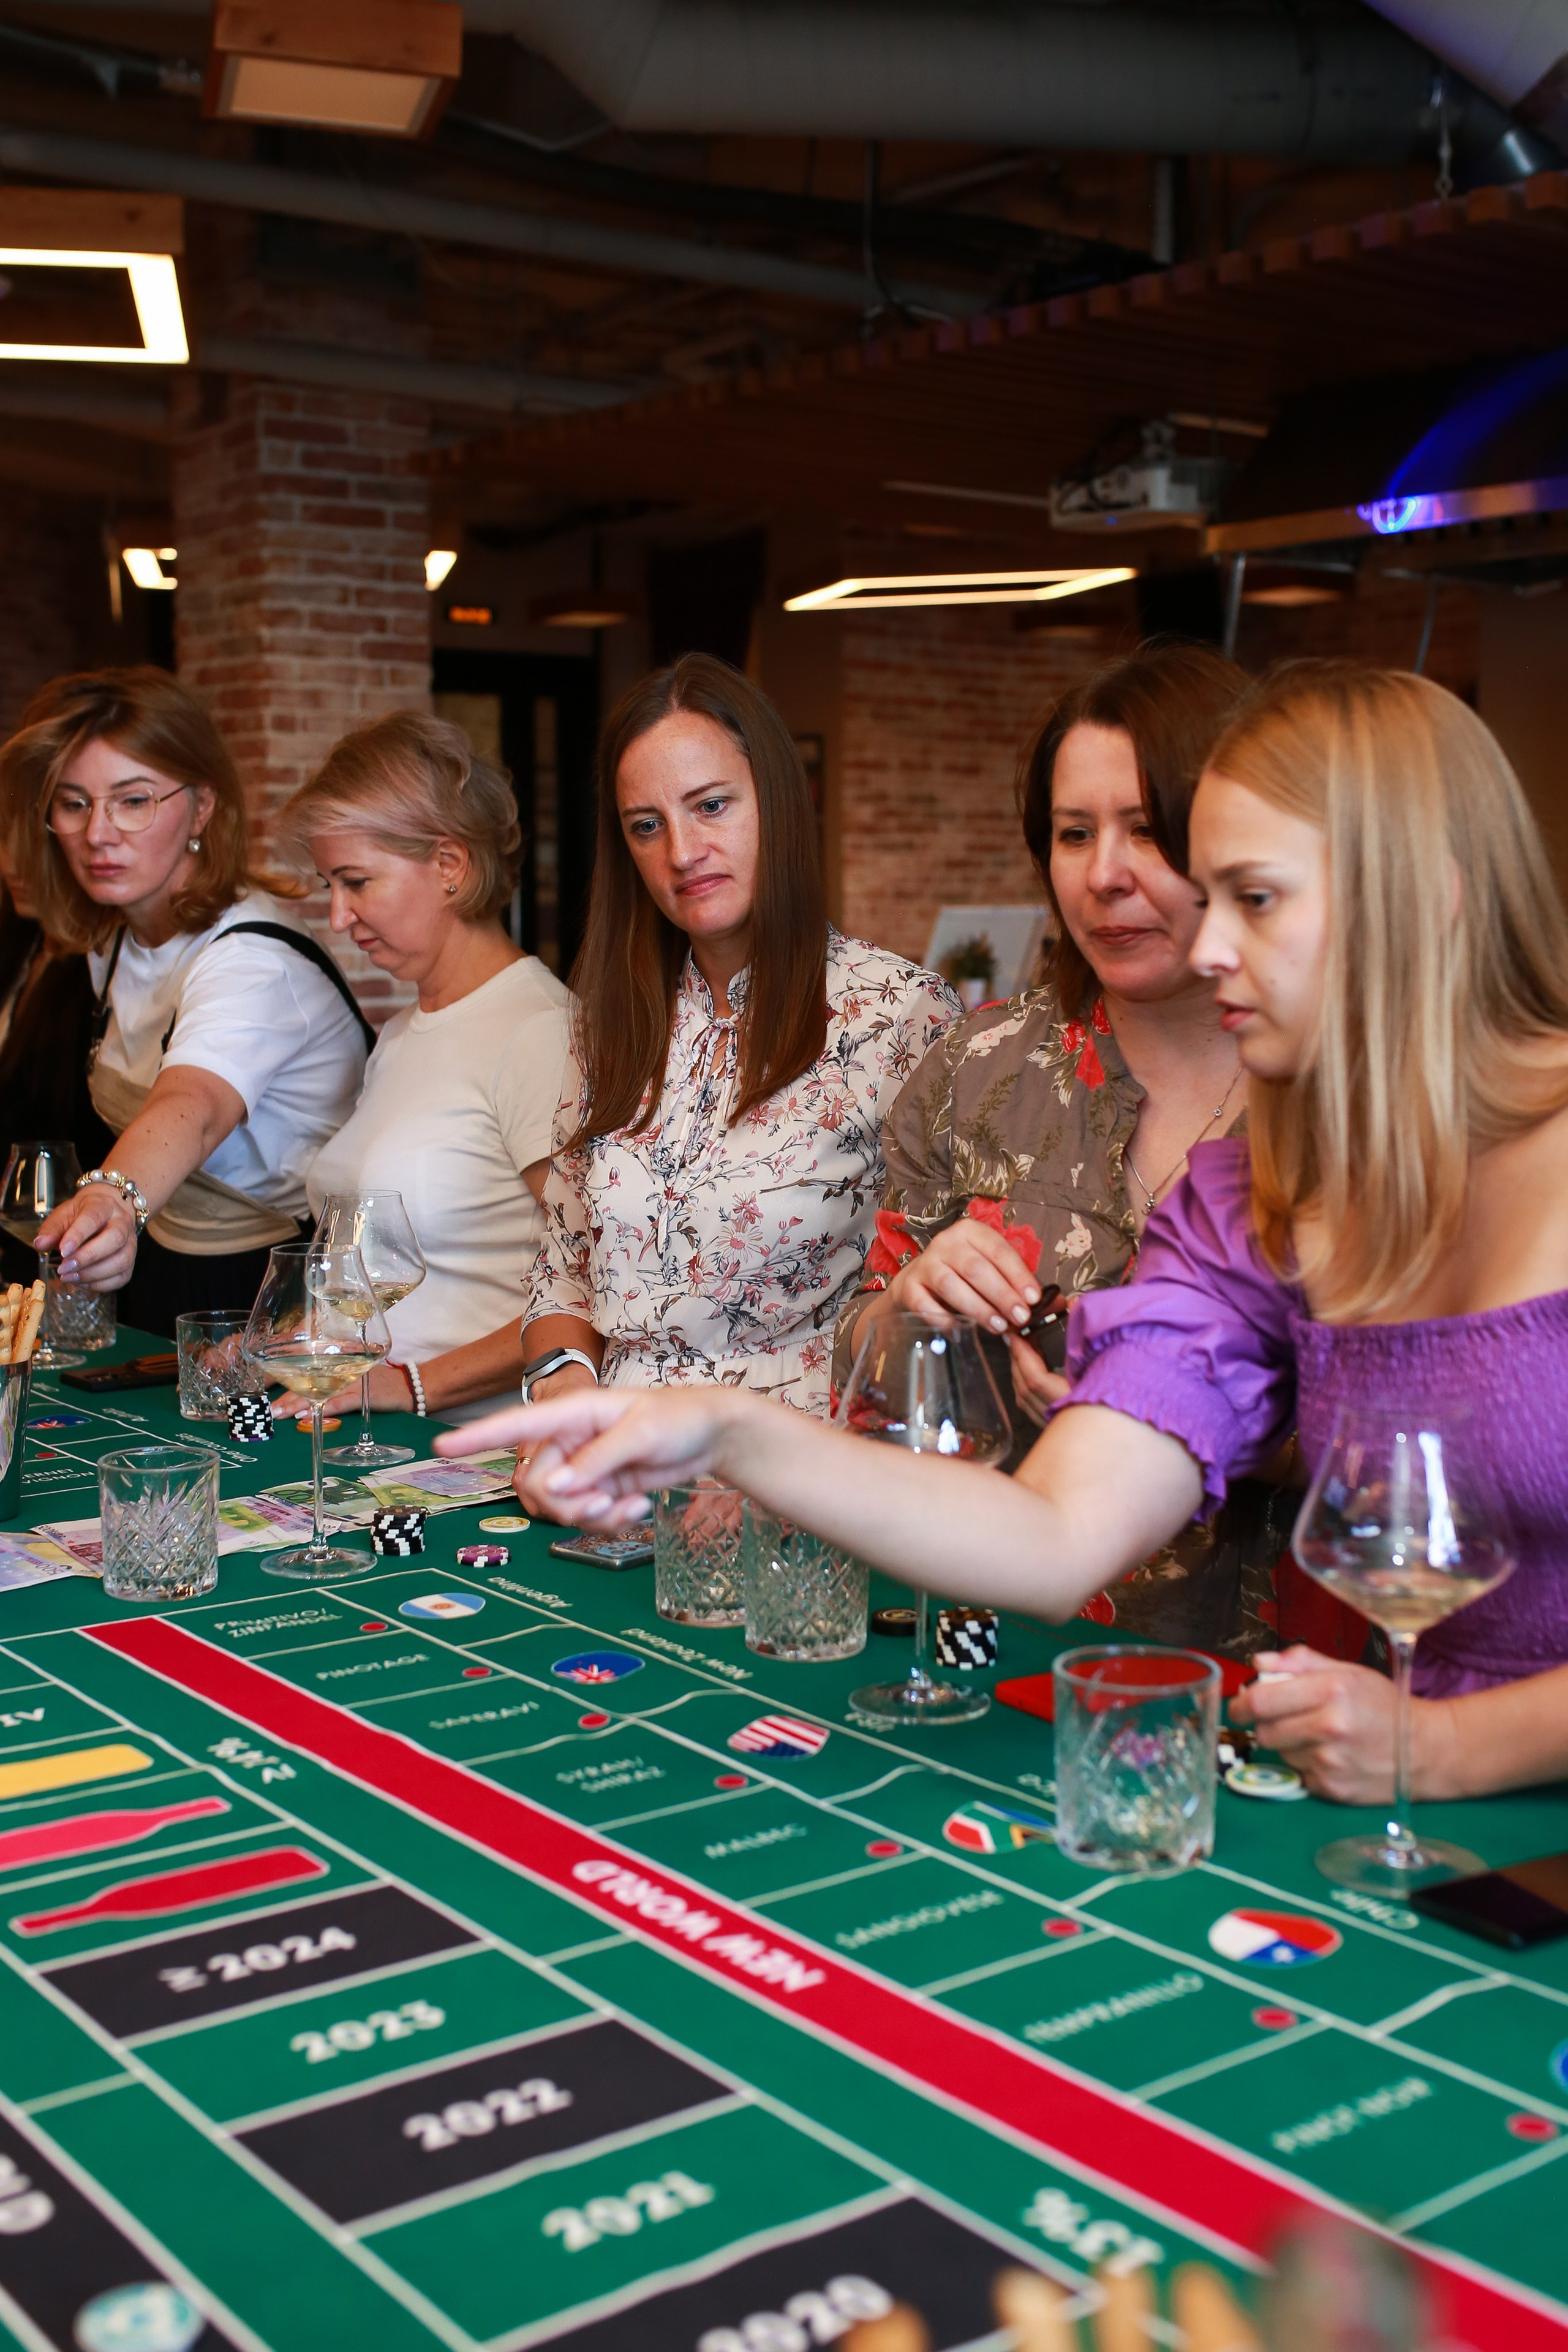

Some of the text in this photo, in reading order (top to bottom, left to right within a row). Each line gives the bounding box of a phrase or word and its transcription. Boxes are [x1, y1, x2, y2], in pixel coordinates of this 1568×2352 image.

[224, 1449, 258, 1463] Other
[22, 1468, 74, 1479] ERNET
[487, 1577, 573, 1608] Argentina
[315, 1653, 430, 1681] PINOTAGE
[620, 1628, 753, 1680] New Zealand
[429, 1701, 540, 1730] SAPERAVI
[580, 1765, 667, 1794] SHIRAZ
[704, 1823, 808, 1860] MALBEC
[571, 1859, 826, 1994] NEW WORLD
[289, 1999, 447, 2065] 2023
[402, 2077, 574, 2152] 2022
[541, 2170, 715, 2253] 2021
